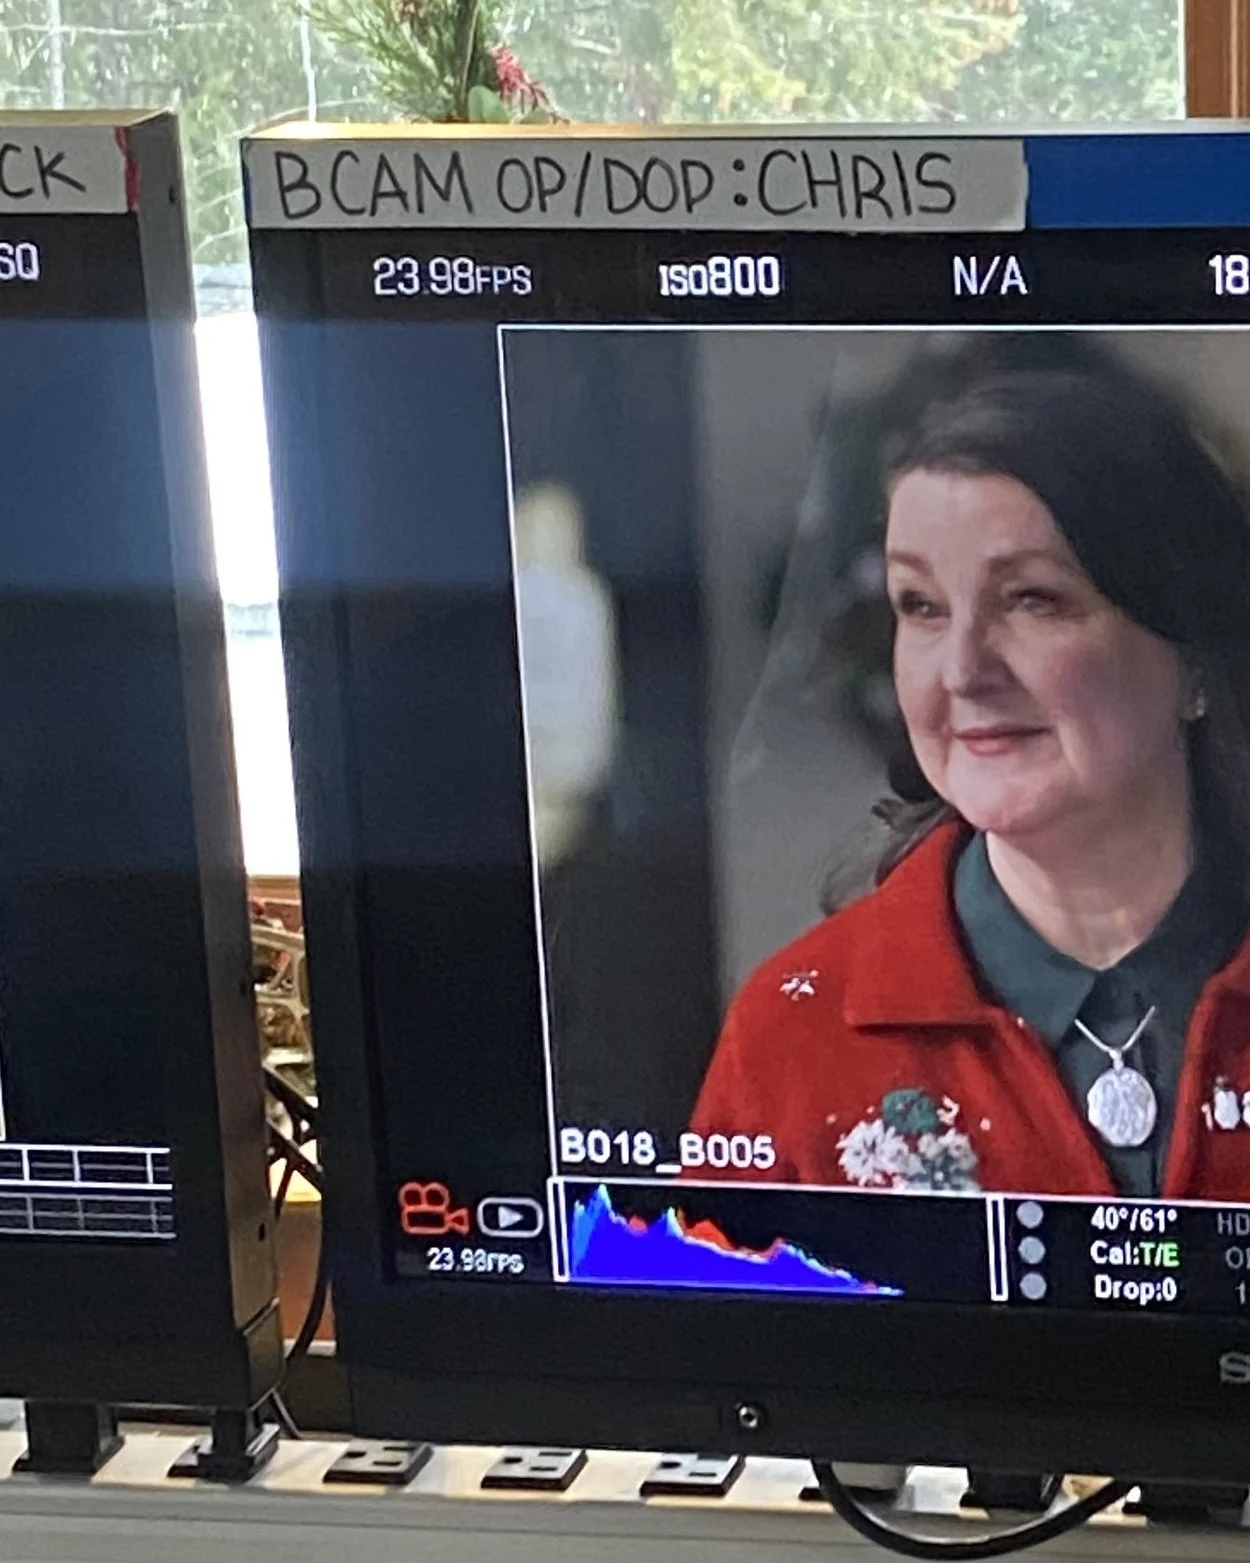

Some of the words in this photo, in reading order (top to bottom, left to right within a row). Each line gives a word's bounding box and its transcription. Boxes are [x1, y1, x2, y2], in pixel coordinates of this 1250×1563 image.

[273, 150, 475, 220] BCAM
[951, 255, 1029, 296] N/A
[559, 1126, 777, 1175] B018_B005
[1093, 1273, 1179, 1307] Drop:0
